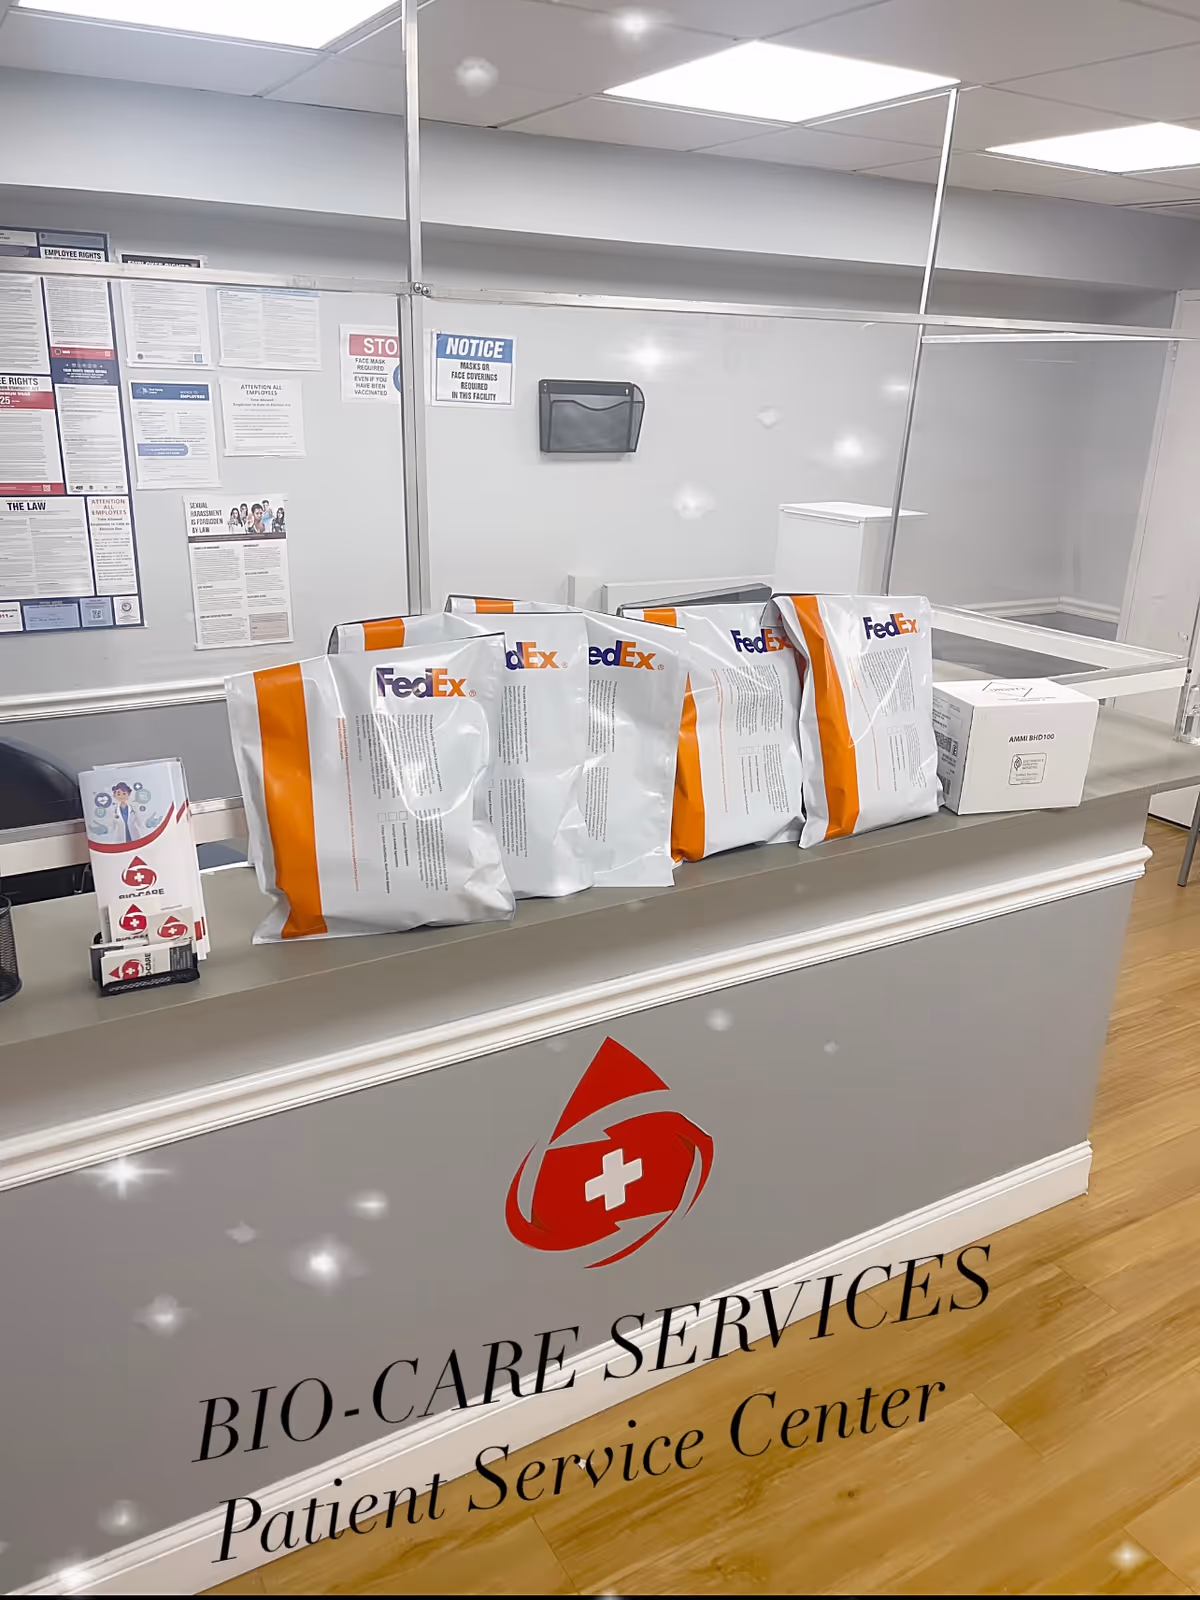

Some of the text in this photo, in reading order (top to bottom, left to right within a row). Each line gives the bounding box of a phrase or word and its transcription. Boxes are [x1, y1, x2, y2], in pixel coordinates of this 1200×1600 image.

[45, 249, 77, 258] EMPLOYEE
[79, 252, 102, 260] RIGHTS
[363, 337, 398, 355] STO
[445, 337, 505, 358] NOTICE
[460, 362, 490, 371] MASKS OR
[9, 377, 38, 386] RIGHTS
[451, 371, 498, 382] FACE COVERINGS
[460, 381, 488, 391] REQUIRED
[451, 391, 496, 401] IN THIS FACILITY
[7, 502, 46, 510] THE LAW
[863, 612, 918, 640] FedEx
[729, 628, 794, 654] FedEx
[505, 641, 560, 670] dEx
[588, 640, 656, 671] edEx
[375, 667, 467, 698] FedEx
[1028, 733, 1055, 742] BHD100
